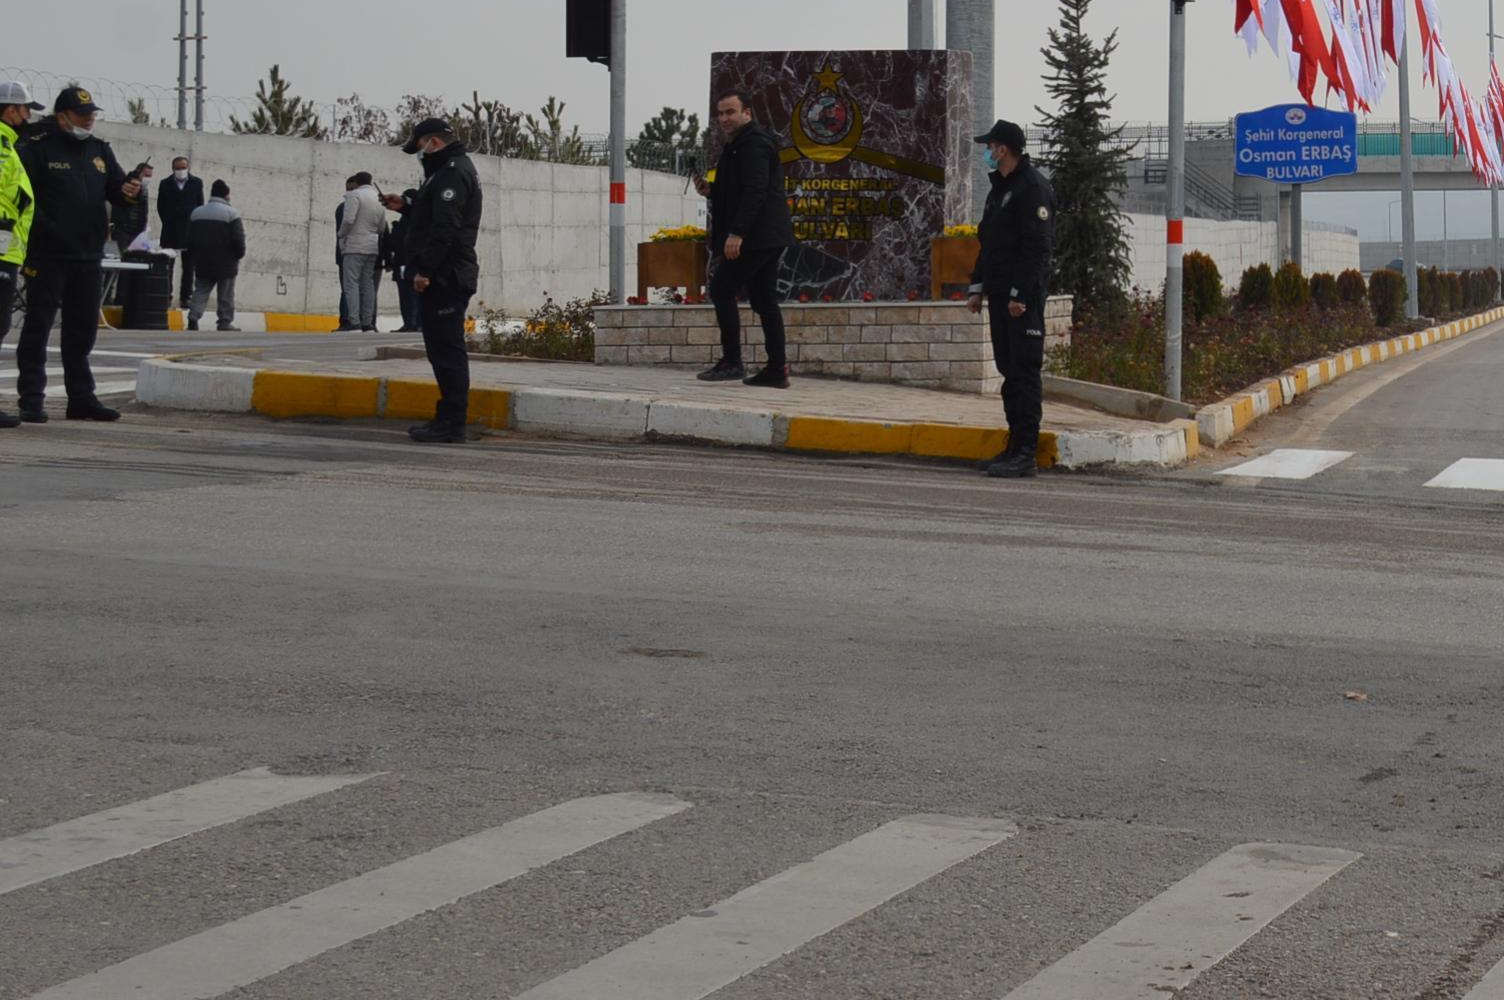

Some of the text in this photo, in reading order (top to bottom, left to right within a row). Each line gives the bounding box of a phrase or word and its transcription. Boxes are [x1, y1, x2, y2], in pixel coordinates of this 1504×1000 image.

[1245, 126, 1344, 144] Şehit Korgeneral
[1239, 145, 1352, 163] Osman ERBAŞ
[1266, 165, 1323, 179] BULVARI
[793, 222, 873, 240] ULVARI
